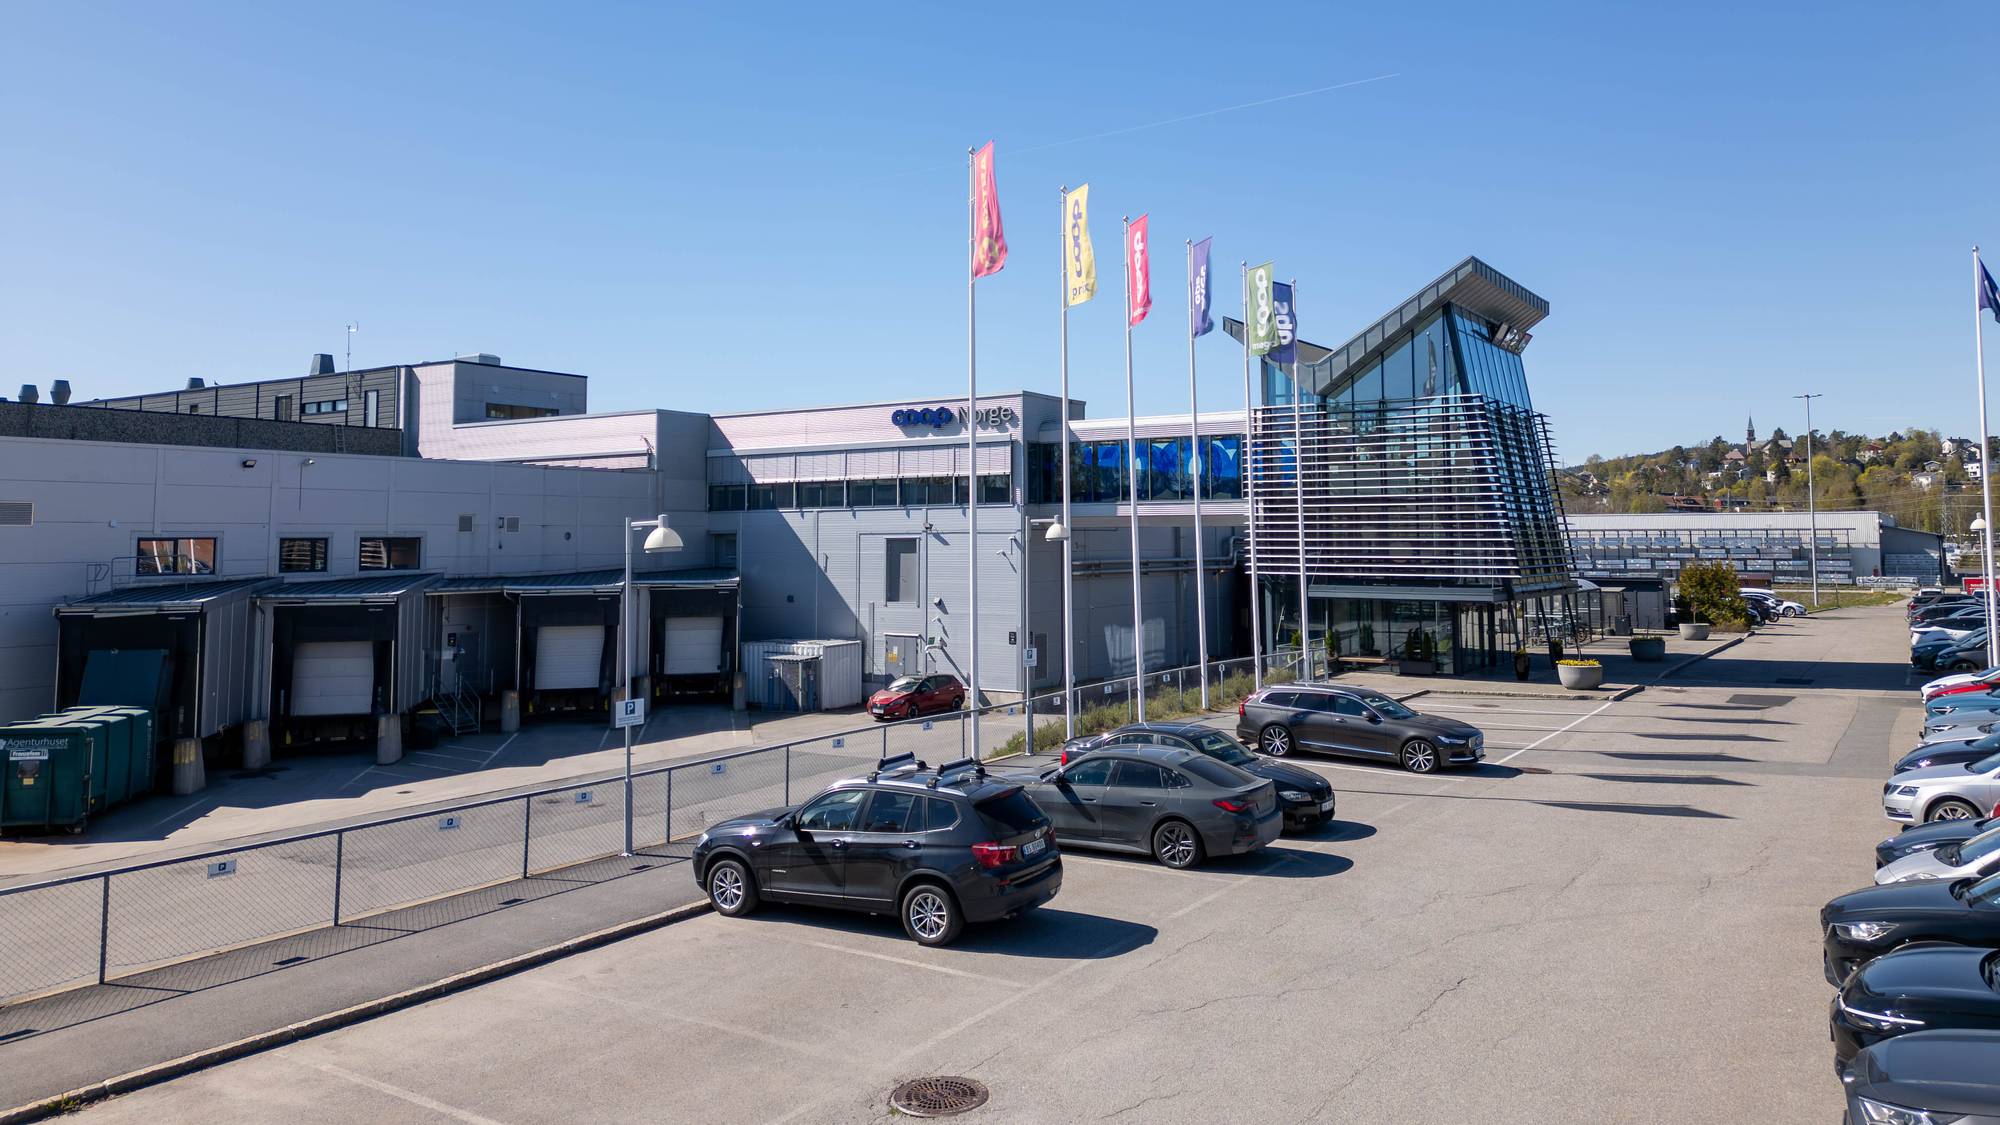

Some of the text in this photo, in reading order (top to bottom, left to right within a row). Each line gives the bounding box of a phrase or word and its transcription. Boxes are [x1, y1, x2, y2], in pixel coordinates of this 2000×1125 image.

[1071, 198, 1083, 278] coop
[1255, 268, 1269, 338] coop
[891, 406, 953, 429] coop
[627, 702, 634, 714] P
[6, 737, 69, 747] Agenturhuset
